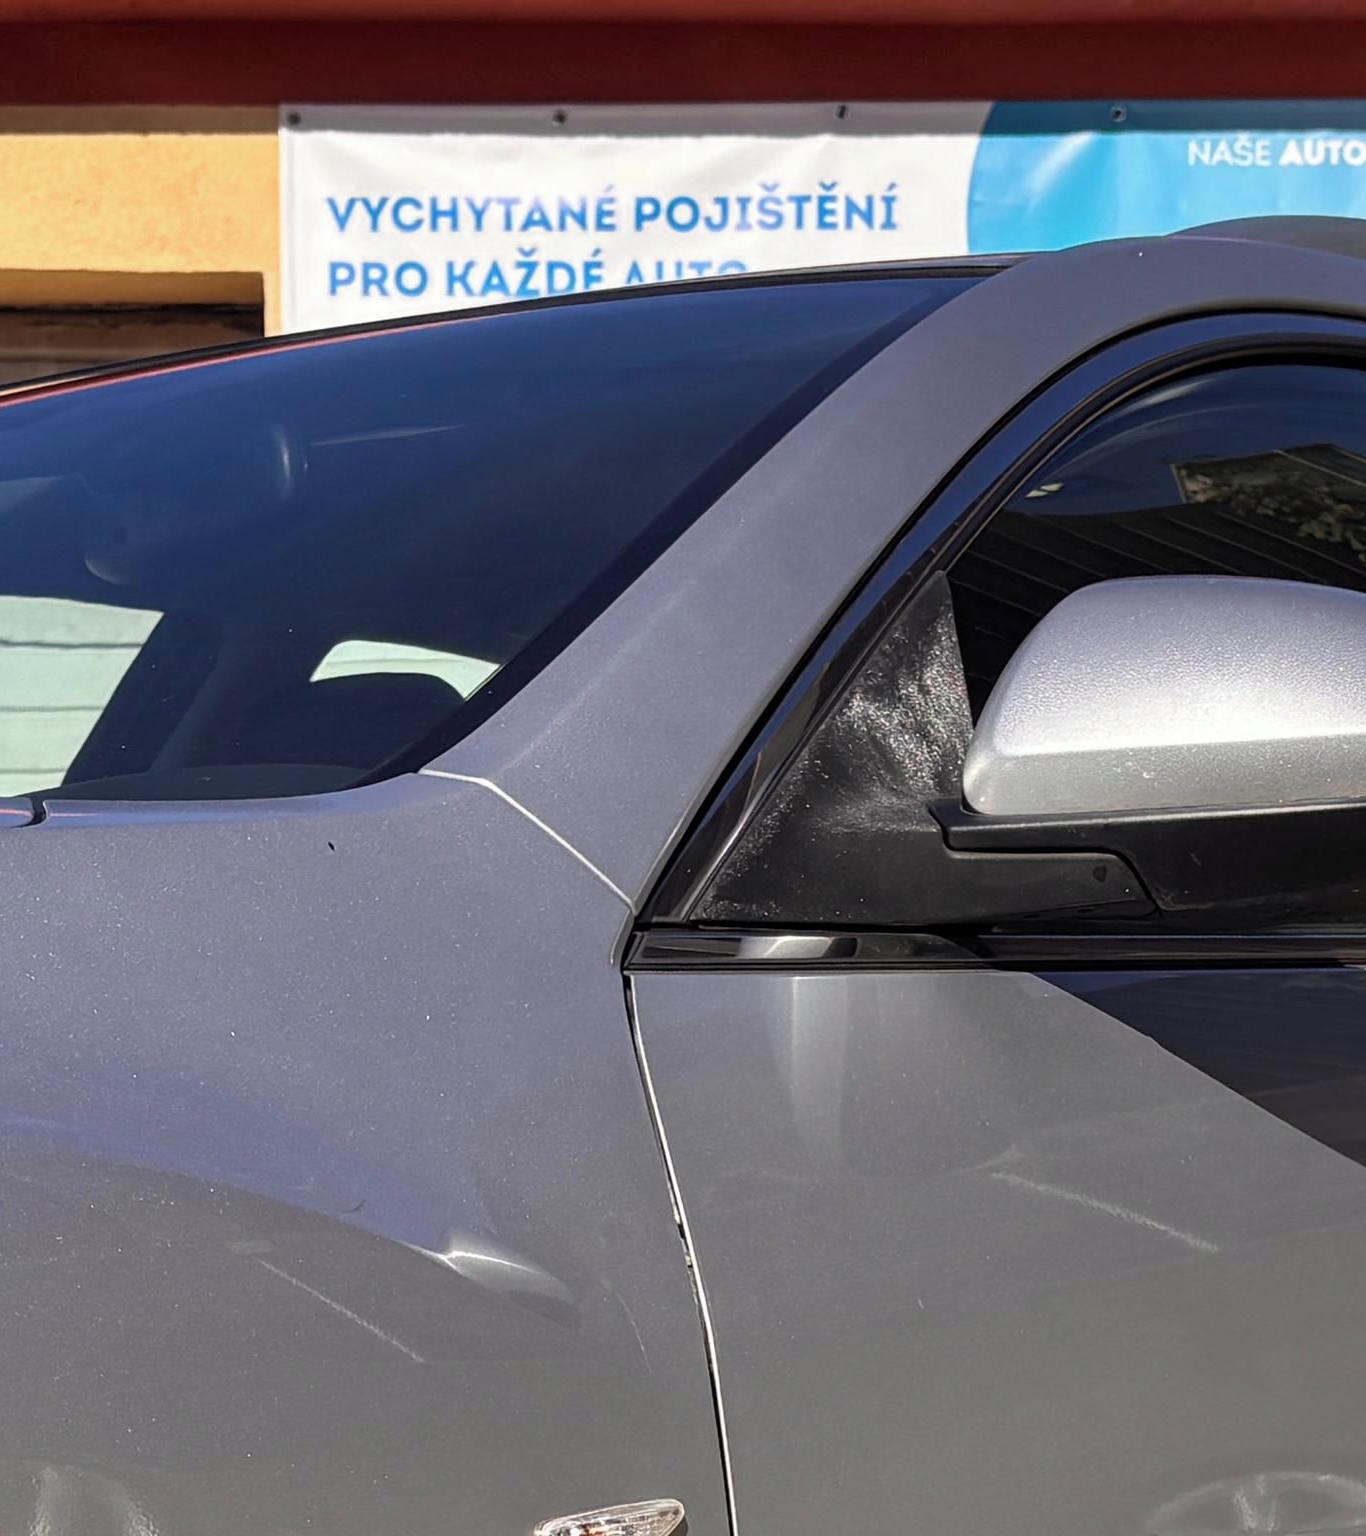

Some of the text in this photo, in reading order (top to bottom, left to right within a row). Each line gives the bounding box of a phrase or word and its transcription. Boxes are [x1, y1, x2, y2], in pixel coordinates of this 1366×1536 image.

[1187, 131, 1272, 167] NAŠE
[326, 181, 899, 233] VYCHYTANÉ POJIŠTĚNÍ
[328, 260, 429, 298] PRO
[445, 246, 604, 298] KAŽDÉ
